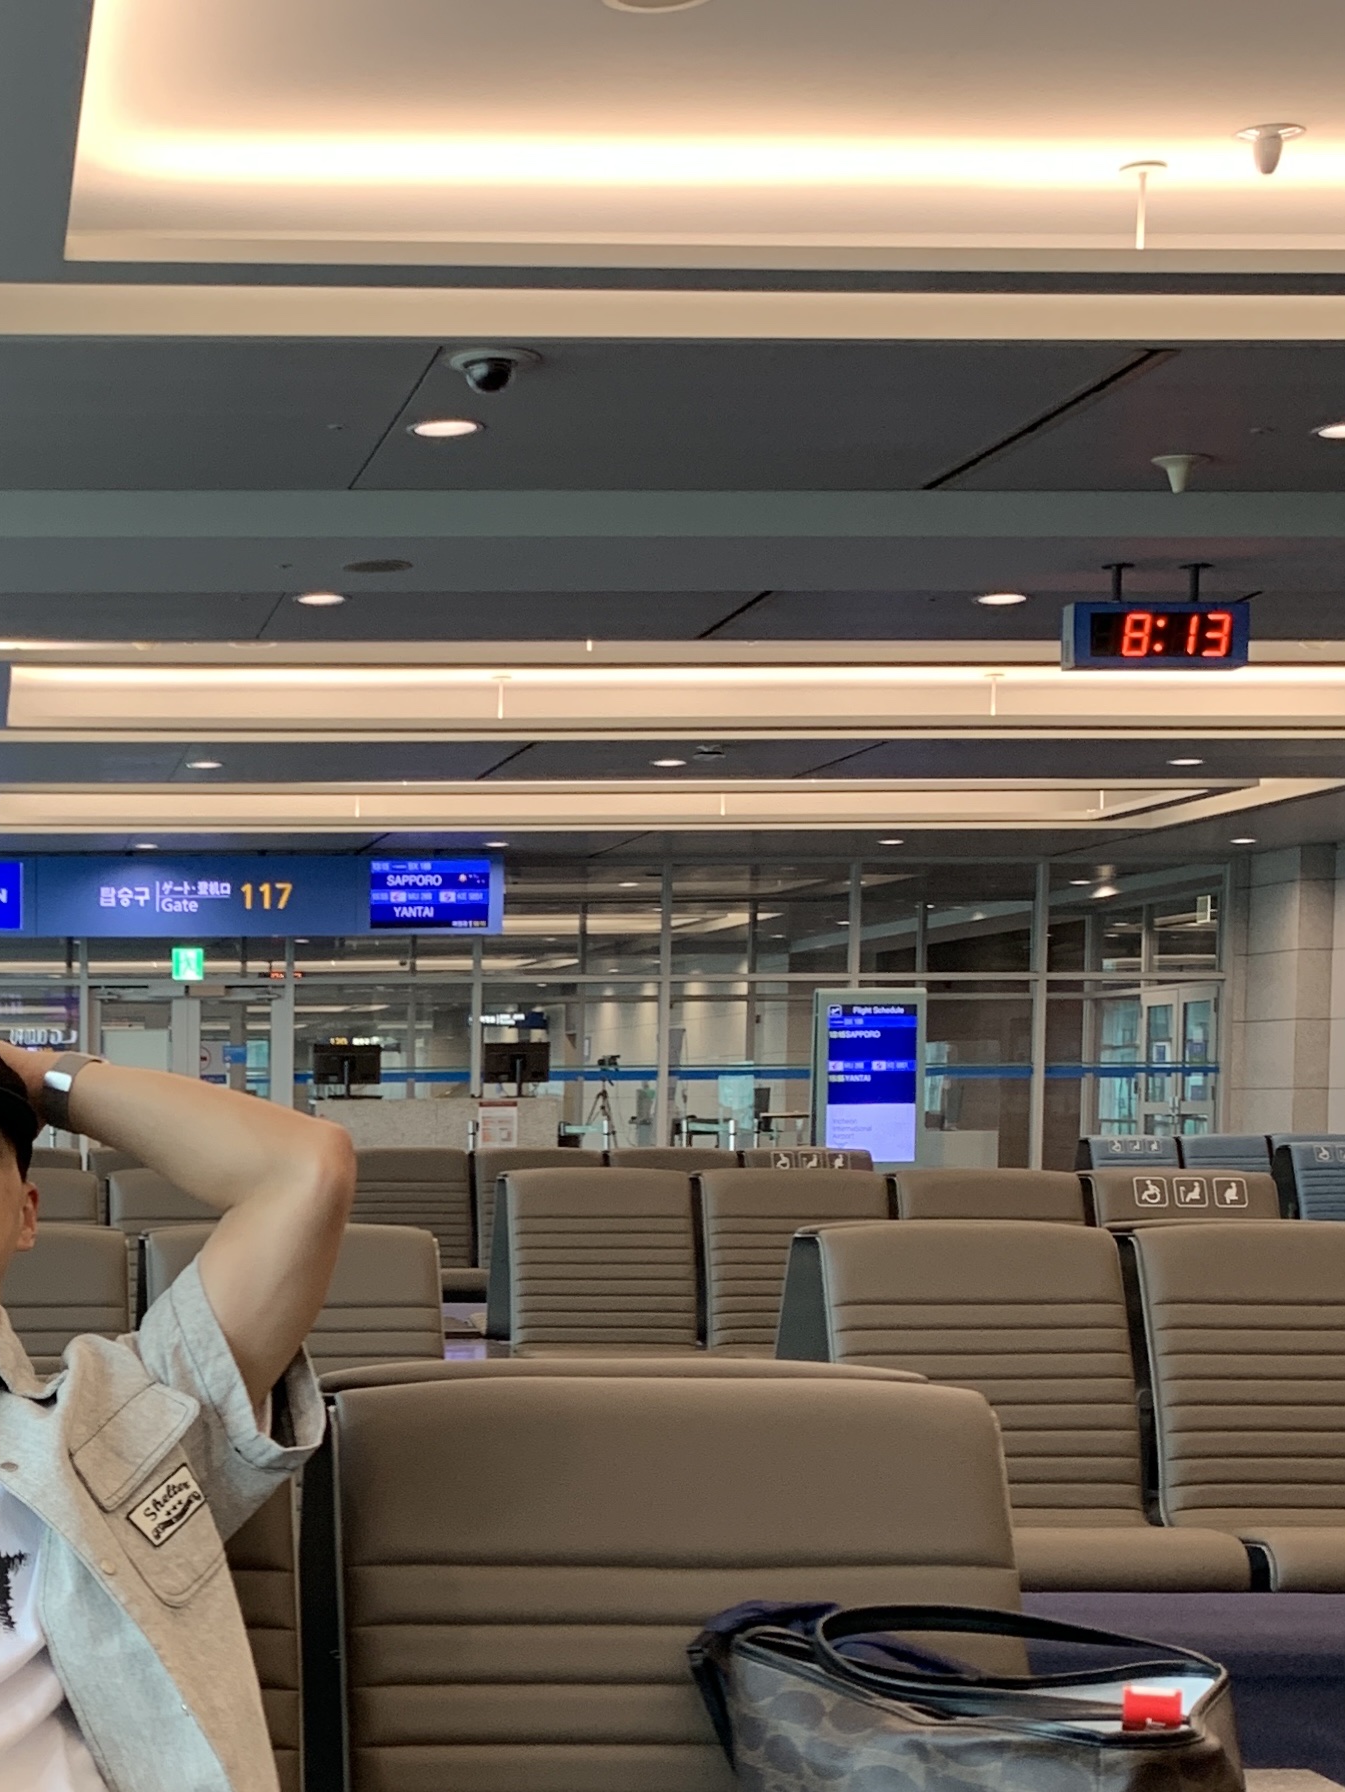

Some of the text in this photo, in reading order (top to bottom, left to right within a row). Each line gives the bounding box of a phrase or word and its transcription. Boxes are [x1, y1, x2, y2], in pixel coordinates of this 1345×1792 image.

[1122, 612, 1233, 657] 8:13
[386, 874, 443, 887] SAPPORO
[99, 886, 151, 908] 탑승구
[240, 882, 293, 911] 117
[161, 898, 199, 913] Gate
[393, 906, 434, 918] YANTAI
[852, 1006, 904, 1015] Flight Schedule
[846, 1029, 881, 1039] SAPPORO
[143, 1481, 191, 1522] Shelter
